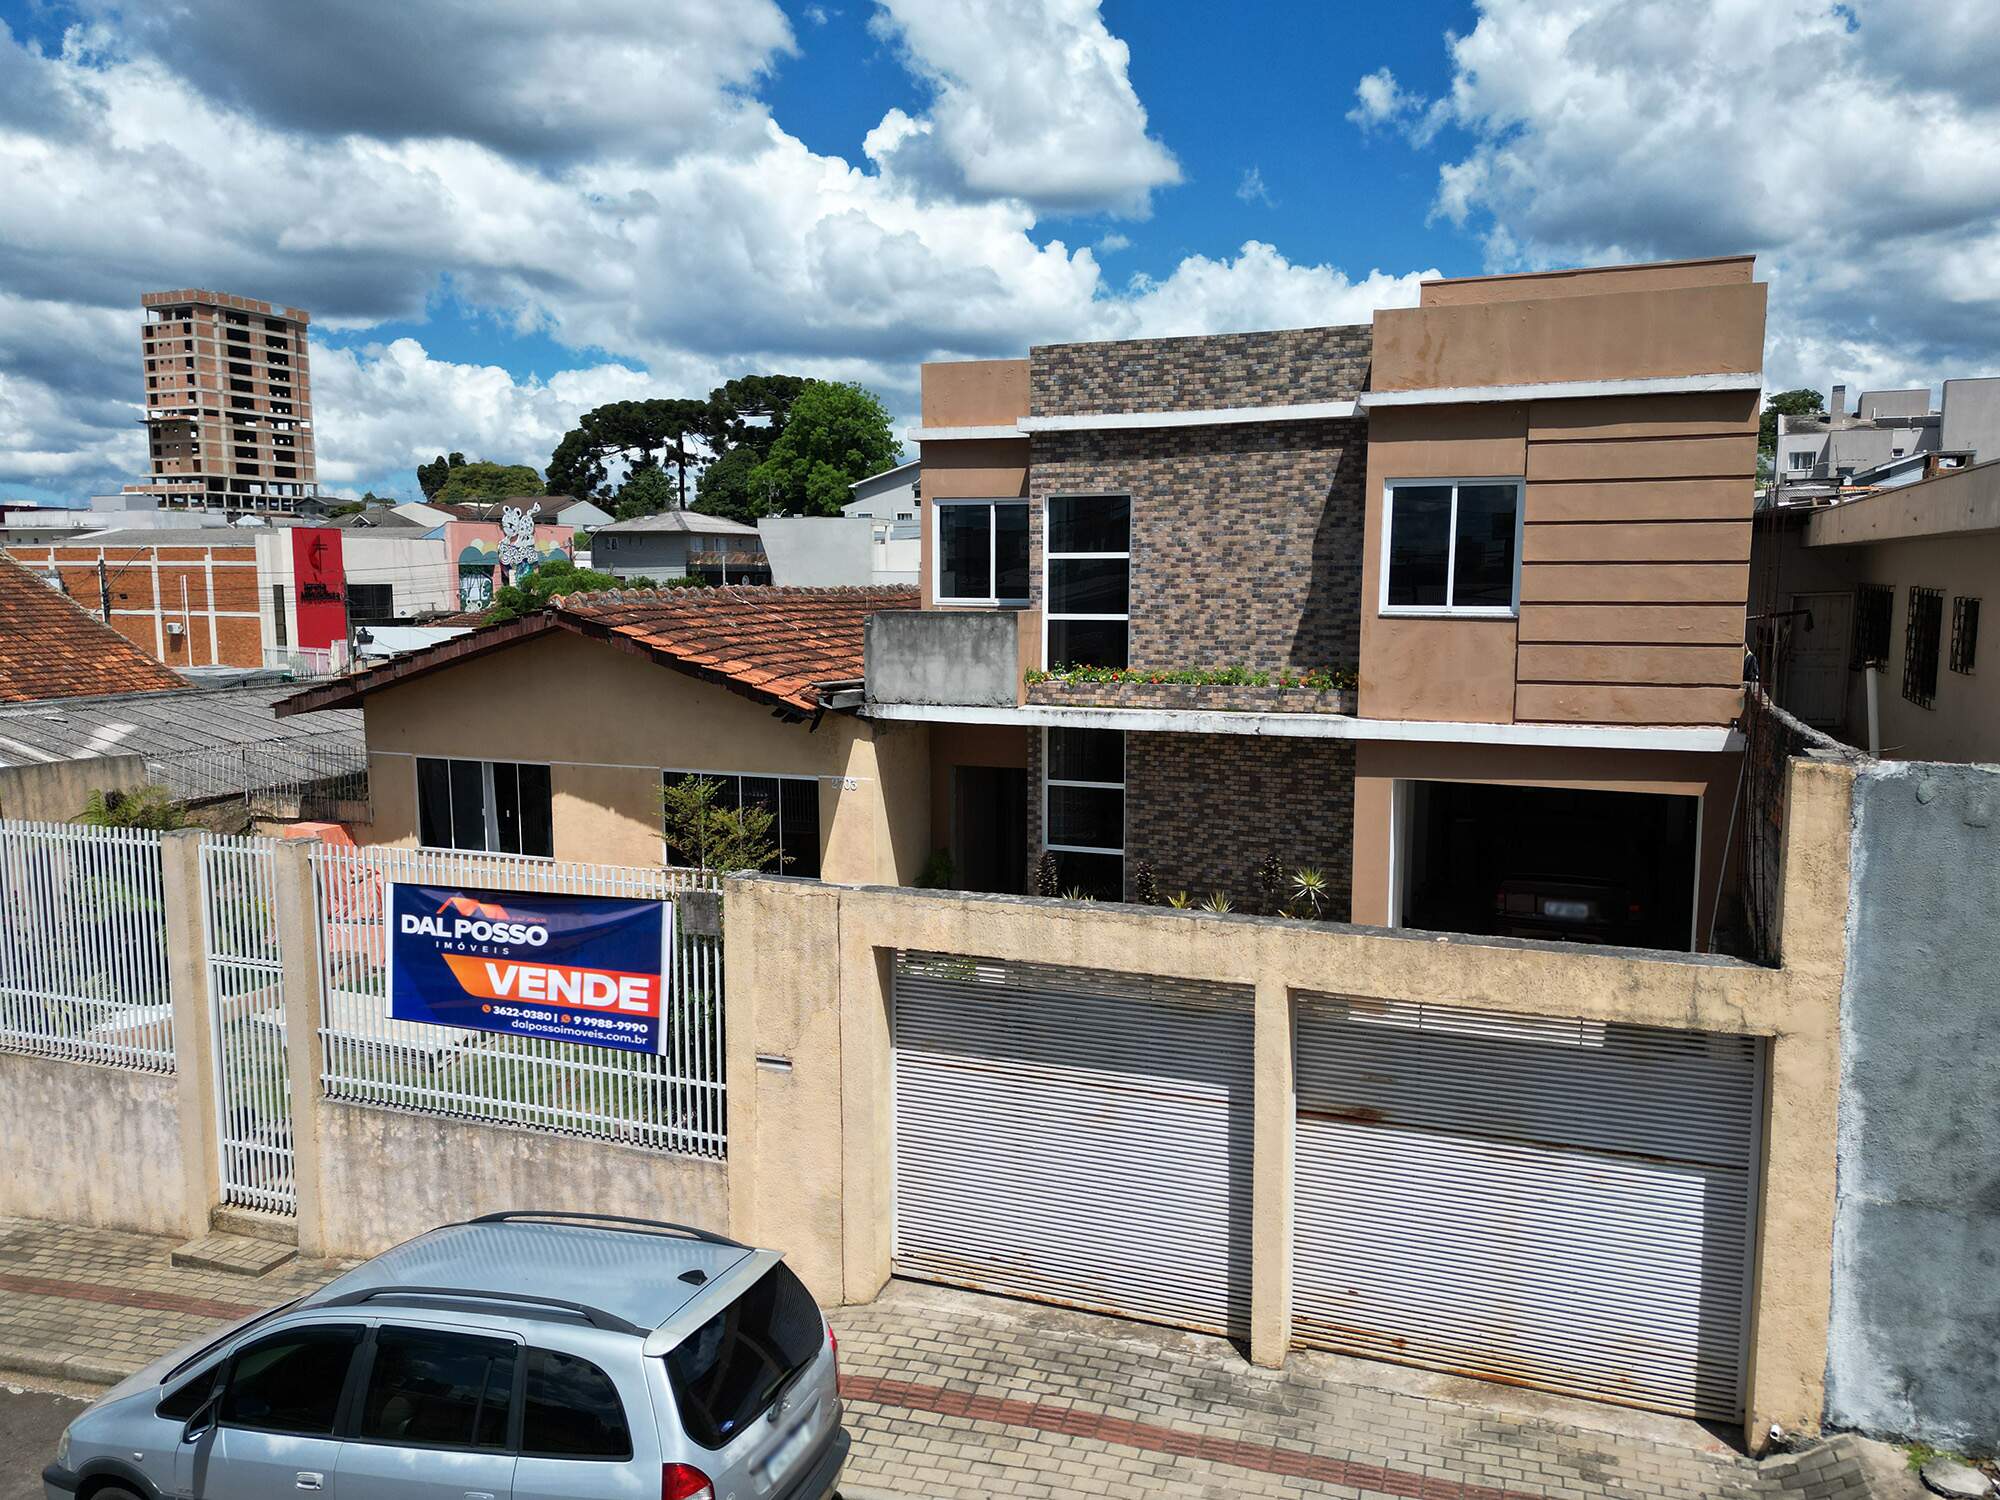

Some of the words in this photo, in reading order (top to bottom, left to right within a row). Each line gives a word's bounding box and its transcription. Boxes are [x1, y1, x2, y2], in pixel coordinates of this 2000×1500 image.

[401, 914, 452, 938] DAL
[455, 919, 549, 946] POSSO
[436, 940, 510, 955] IMÓVEIS
[485, 963, 650, 1012] VENDE
[493, 1005, 552, 1021] 3622-0380
[583, 1017, 649, 1034] 9988-9990
[511, 1019, 648, 1045] dalpossoimoveis.com.br
